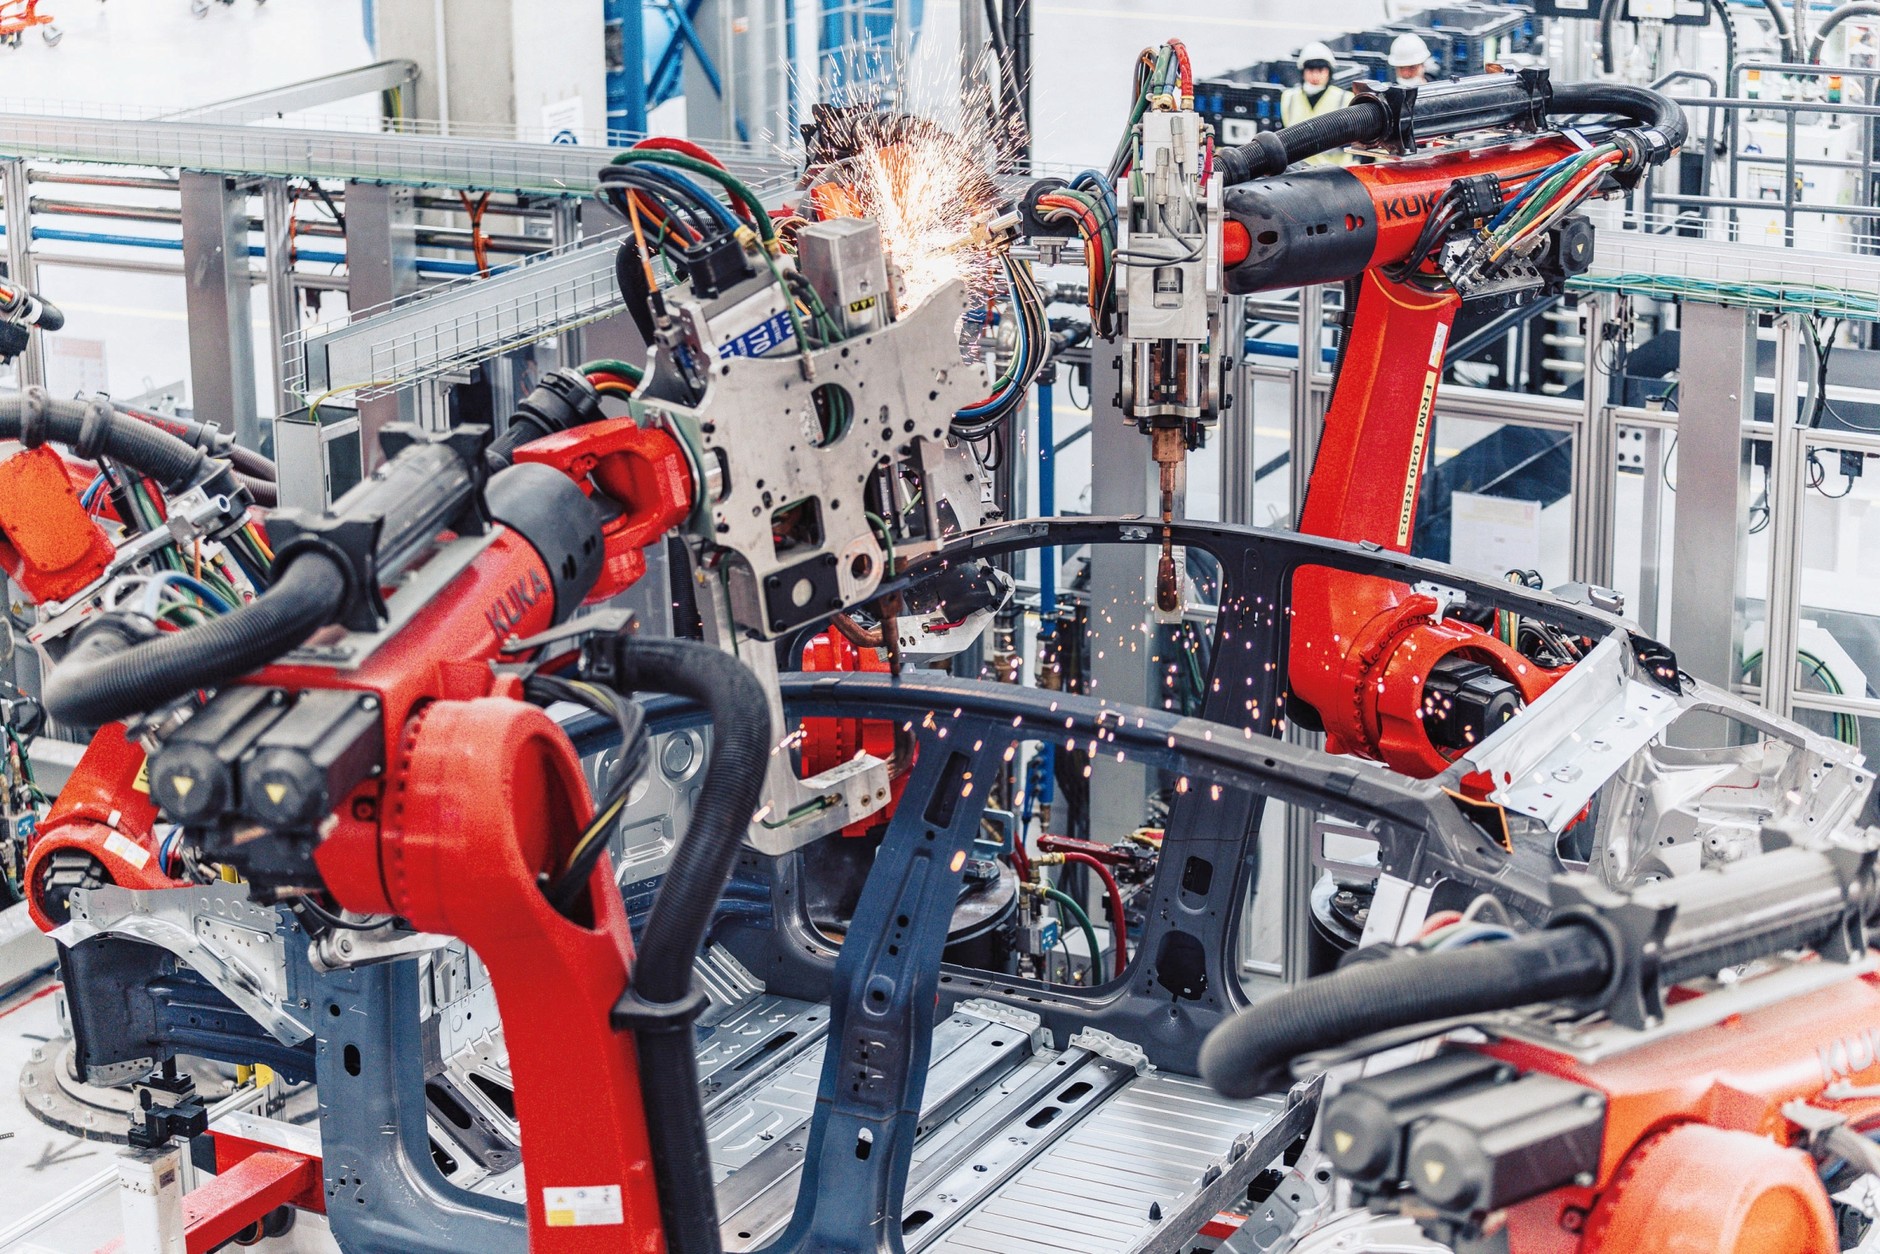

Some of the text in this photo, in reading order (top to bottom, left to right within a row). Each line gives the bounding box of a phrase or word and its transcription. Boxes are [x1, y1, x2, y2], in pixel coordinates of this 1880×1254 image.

[1382, 192, 1436, 221] KUK
[748, 325, 771, 354] 170
[1400, 384, 1432, 536] FRM1 040 RB03
[485, 567, 547, 641] KUKA
